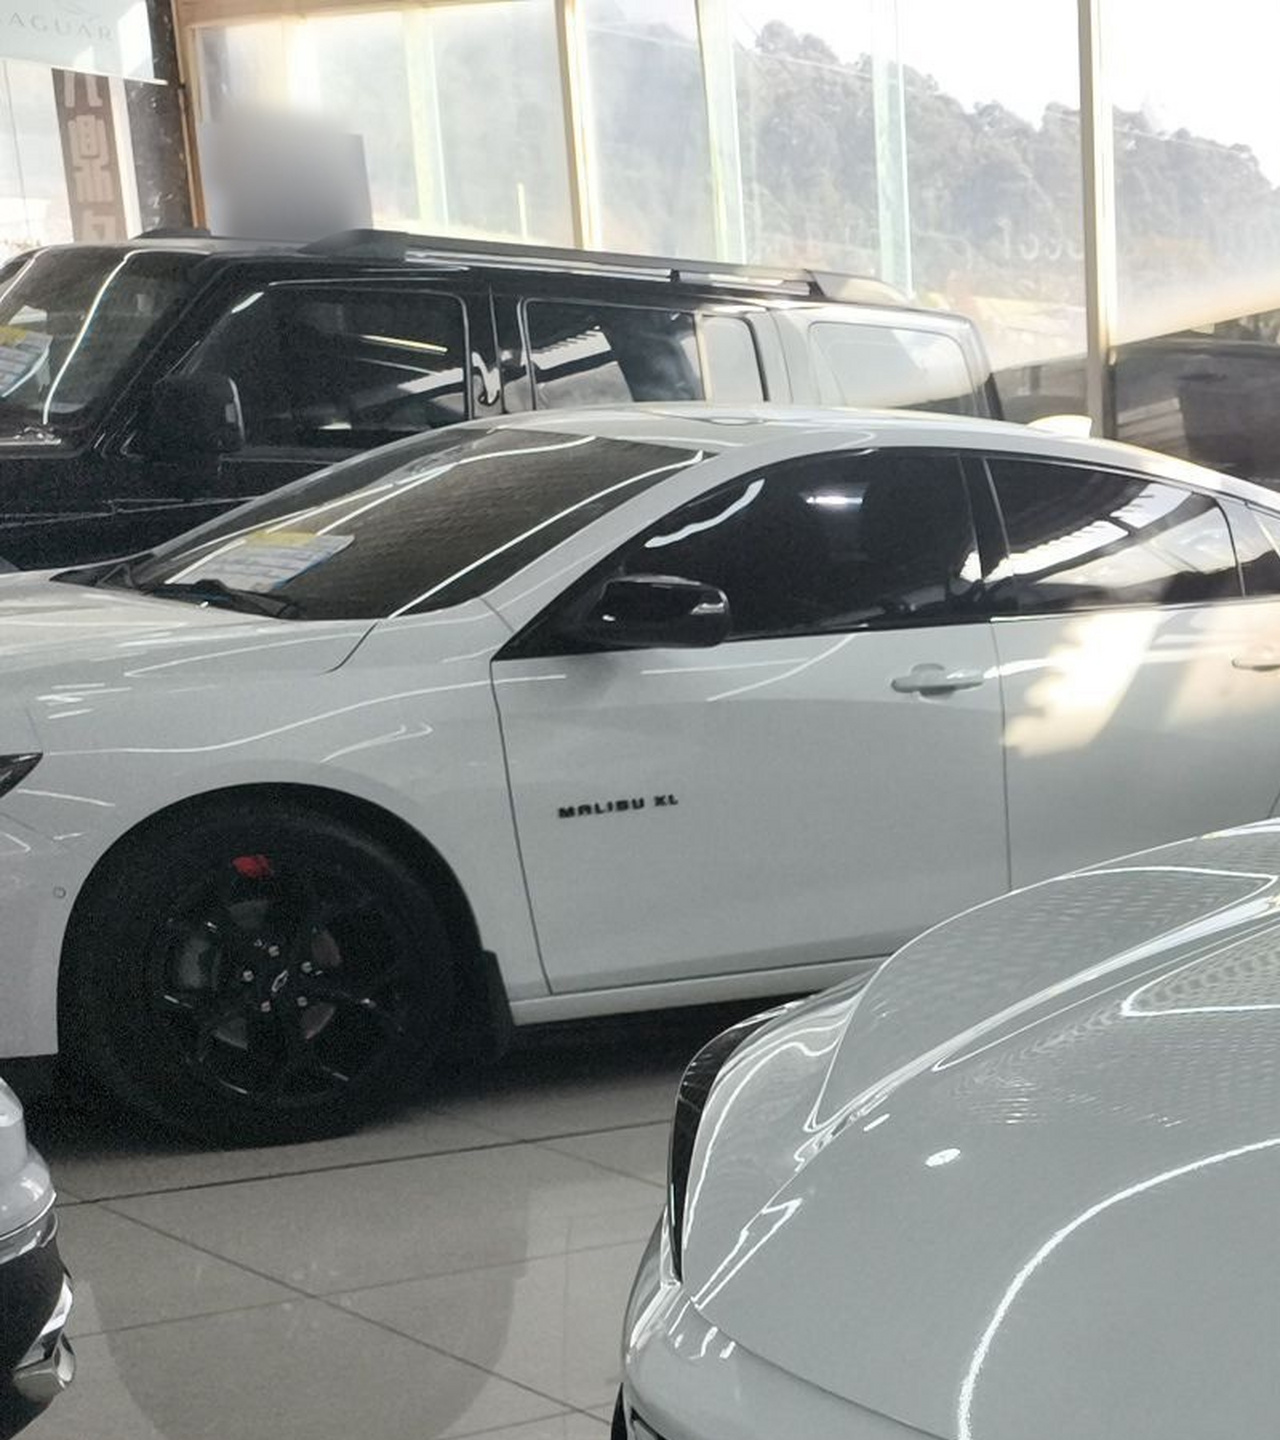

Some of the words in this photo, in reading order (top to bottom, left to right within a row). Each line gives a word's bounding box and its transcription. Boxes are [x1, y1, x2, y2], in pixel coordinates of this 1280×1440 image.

[0, 11, 113, 41] AGUAR
[558, 798, 645, 818] MALIBU
[654, 794, 679, 807] XL
